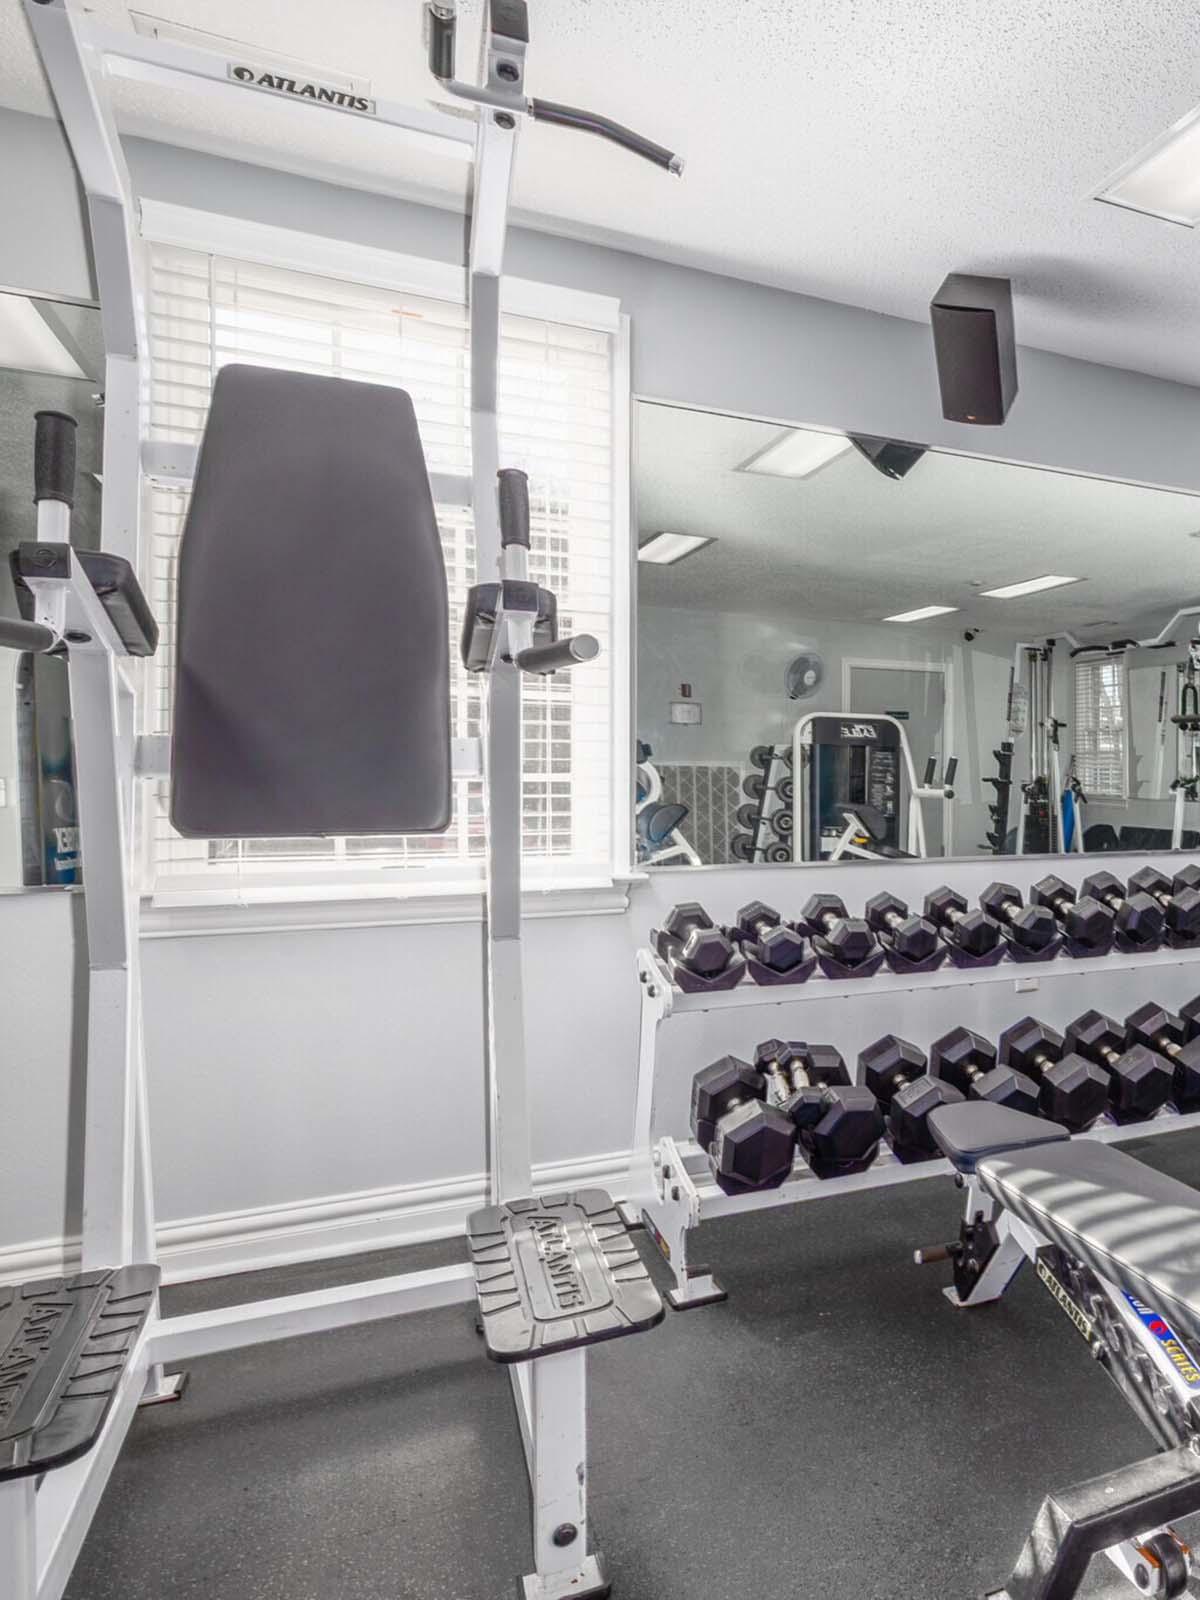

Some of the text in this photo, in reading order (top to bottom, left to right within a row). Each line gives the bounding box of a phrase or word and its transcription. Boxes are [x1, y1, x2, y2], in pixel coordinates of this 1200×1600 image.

[257, 74, 368, 111] ATLANTIS
[528, 1219, 586, 1309] ATLANTIS
[1162, 1339, 1200, 1384] SERIES
